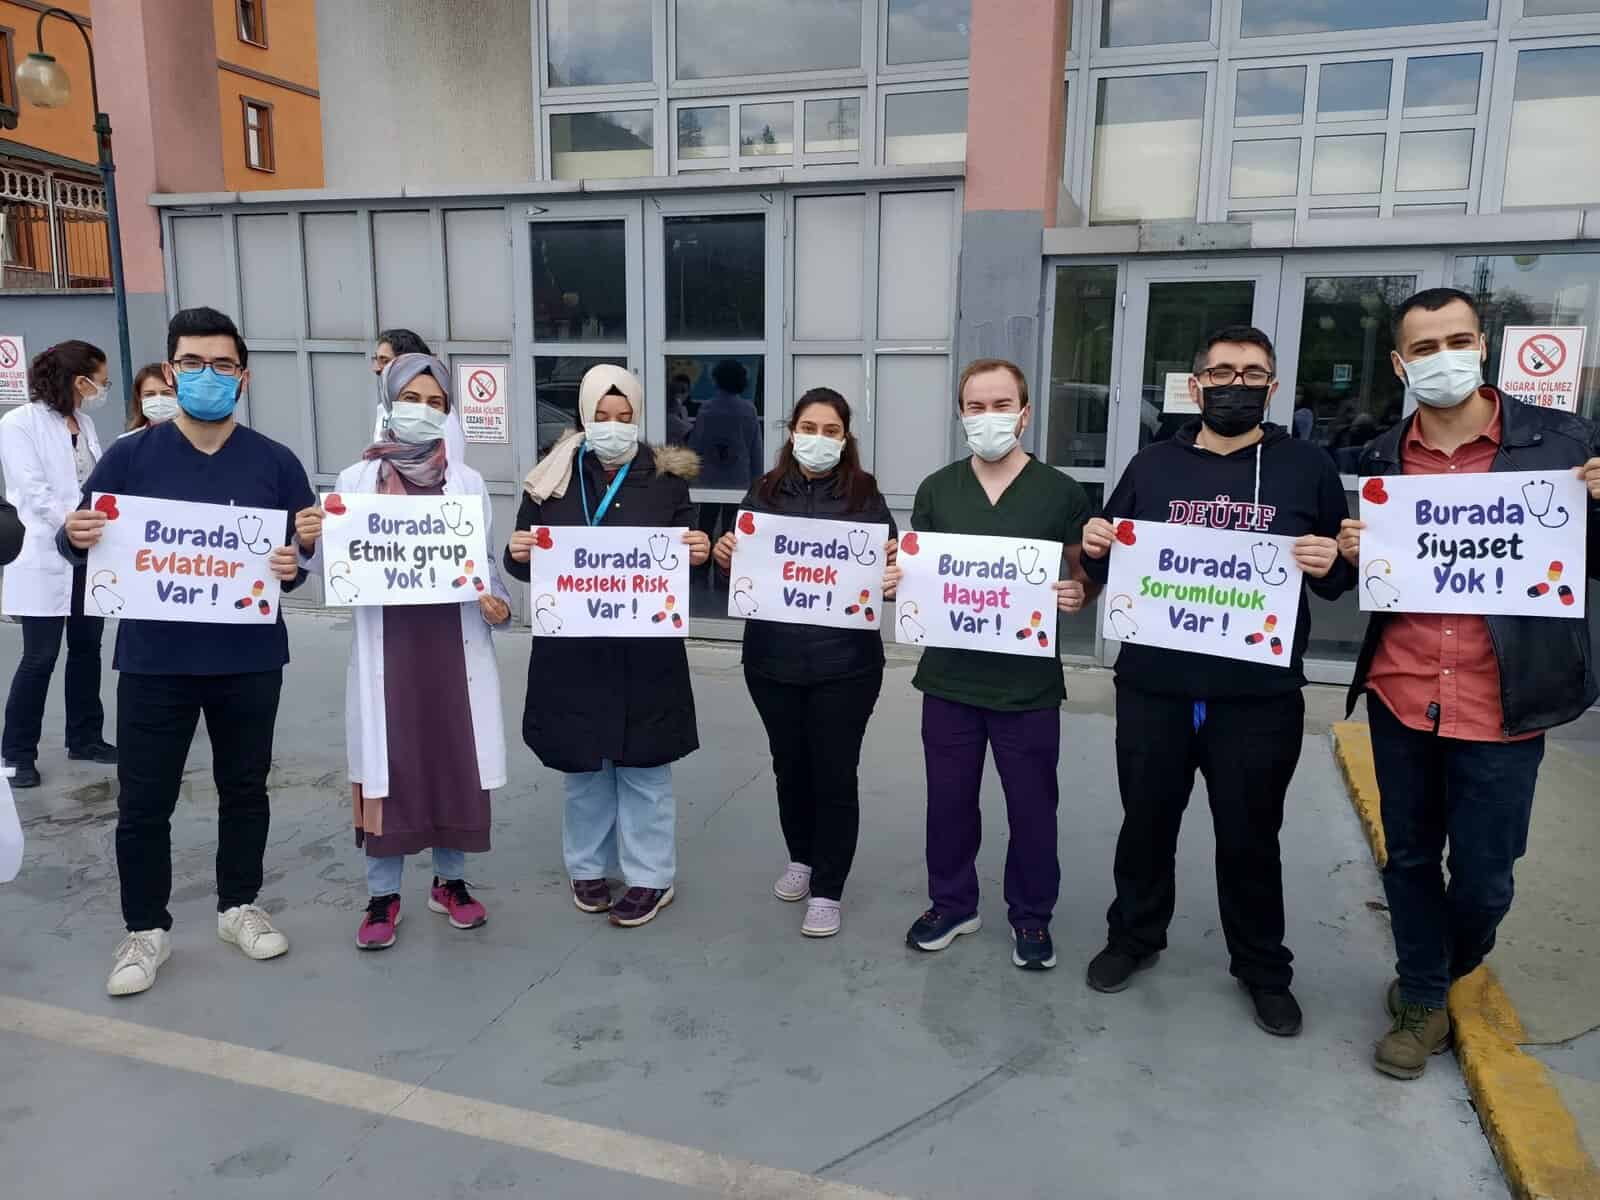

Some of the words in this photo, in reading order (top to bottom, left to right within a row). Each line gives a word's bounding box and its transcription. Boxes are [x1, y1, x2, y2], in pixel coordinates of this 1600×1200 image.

[1556, 395, 1567, 404] TL
[1167, 495, 1276, 531] DEÜTF
[1416, 496, 1524, 525] Burada
[145, 518, 240, 549] Burada
[368, 513, 445, 535] Burada
[349, 540, 405, 561] Etnik
[414, 545, 466, 569] grup
[575, 548, 650, 569] Burada
[775, 535, 849, 560] Burada
[1416, 532, 1524, 567] Siyaset
[136, 550, 244, 578] Evlatlar
[783, 561, 837, 585] Emek
[939, 554, 1017, 580] Burada
[1159, 549, 1251, 581] Burada
[385, 568, 422, 588] Yok
[430, 568, 435, 587] !
[557, 575, 625, 592] Mesleki
[633, 575, 668, 592] Risk
[1433, 566, 1485, 594] Yok
[1496, 567, 1503, 594] !
[157, 580, 203, 604] Var
[212, 584, 218, 605] !
[784, 587, 820, 608] Var
[827, 591, 832, 611] !
[944, 583, 1009, 613] Hayat
[1140, 576, 1266, 610] Sorumluluk
[588, 599, 625, 619] Var
[632, 599, 637, 619] !
[1169, 606, 1214, 632] Var
[1222, 613, 1229, 636] !
[950, 611, 989, 633] Var
[996, 614, 1001, 635] !
